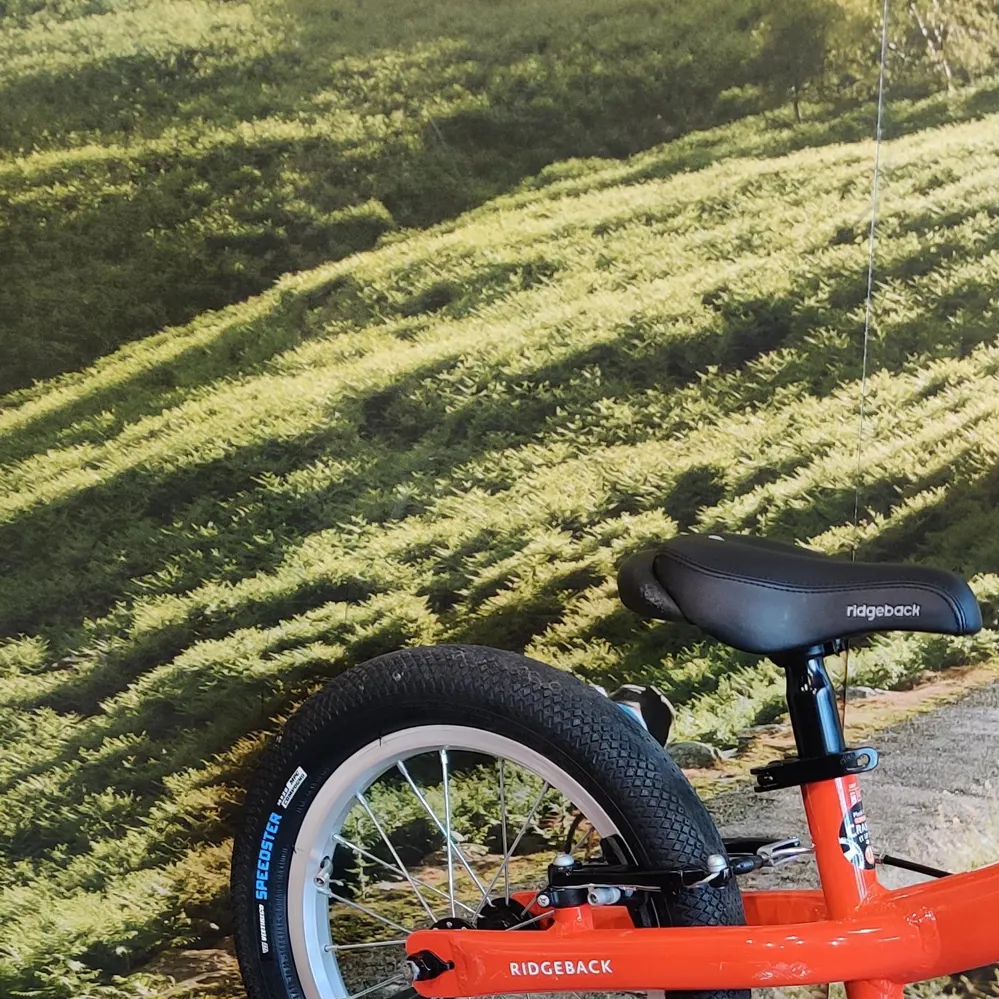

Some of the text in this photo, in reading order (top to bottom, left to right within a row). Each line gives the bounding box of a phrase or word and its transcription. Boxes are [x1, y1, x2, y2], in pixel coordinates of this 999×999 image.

[846, 603, 921, 621] ridgeback
[255, 812, 282, 900] SPEEDSTER
[509, 960, 613, 976] RIDGEBACK
